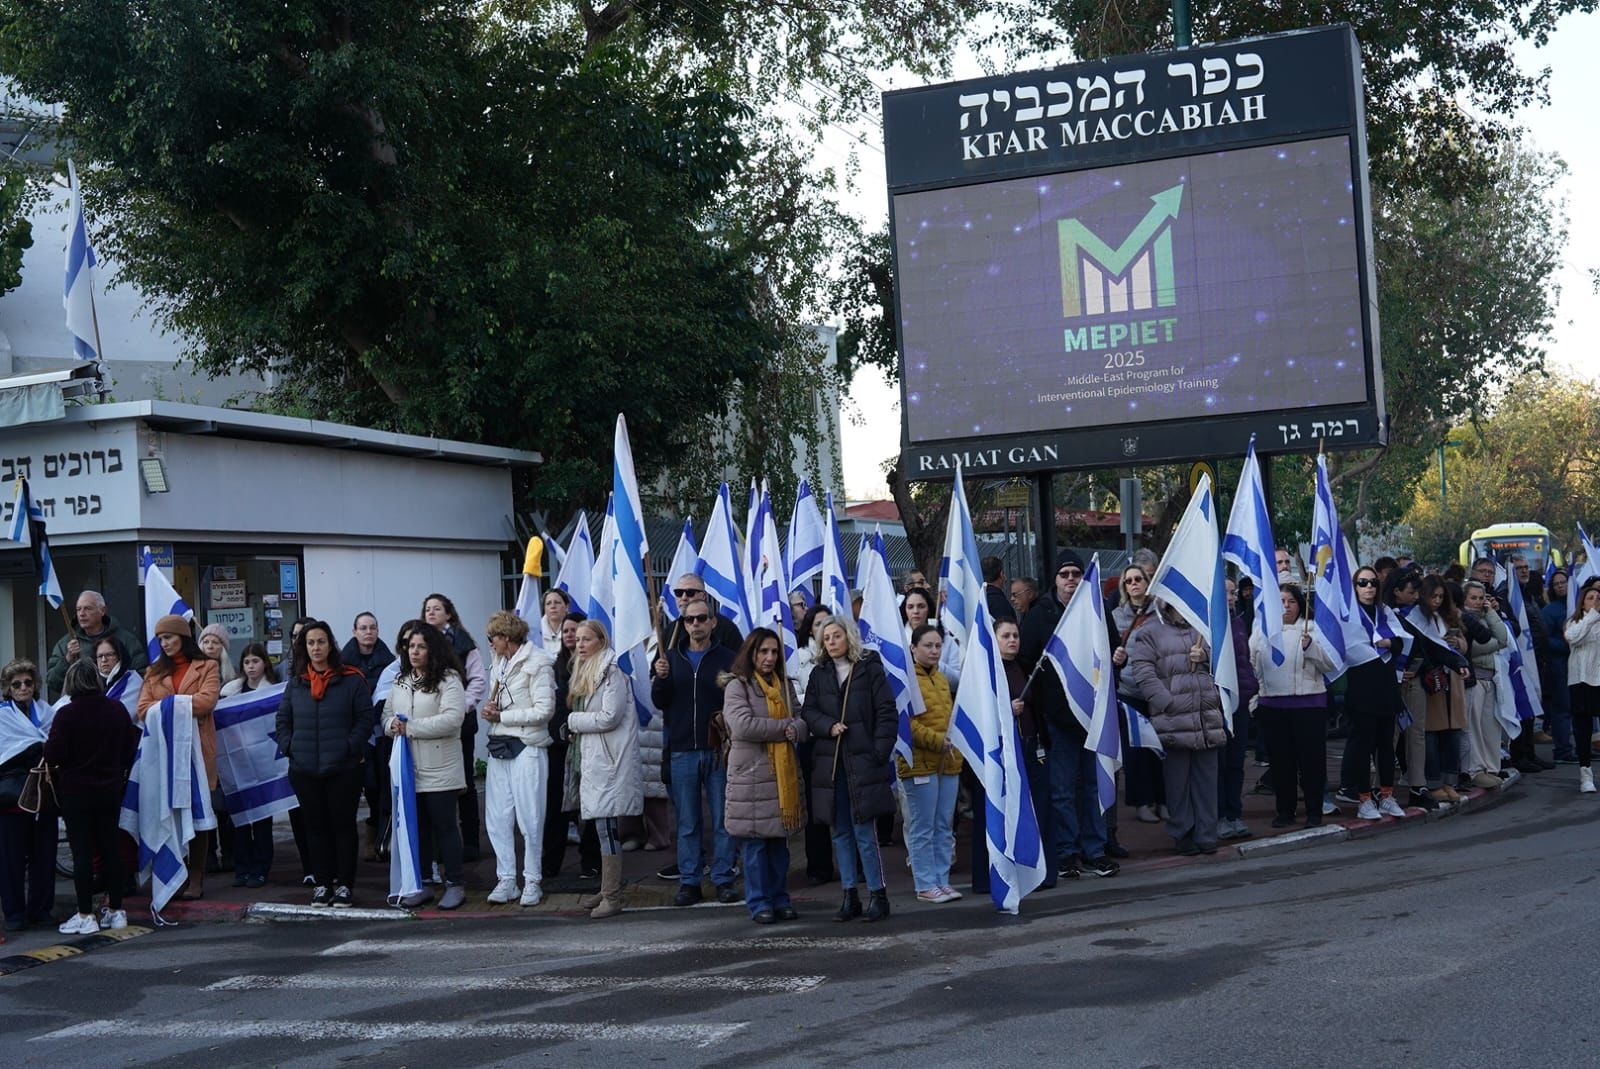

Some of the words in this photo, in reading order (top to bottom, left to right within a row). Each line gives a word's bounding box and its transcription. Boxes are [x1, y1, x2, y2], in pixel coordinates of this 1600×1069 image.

[1167, 52, 1265, 97] כפר
[959, 69, 1147, 130] המכביה
[961, 126, 1049, 160] KFAR
[1060, 94, 1267, 147] MACCABIAH
[1064, 318, 1177, 352] MEPIET
[1104, 350, 1145, 369] 2025
[1067, 371, 1124, 386] Middle-East
[1126, 368, 1168, 382] Program
[1171, 365, 1185, 376] for
[1038, 385, 1105, 402] Interventional
[1108, 381, 1175, 398] Epidemiology
[1177, 377, 1219, 391] Training
[1278, 424, 1301, 445] גן
[1311, 419, 1359, 438] רמת
[43, 448, 123, 478] ברוכים
[919, 449, 1001, 471] RAMAT
[1008, 444, 1058, 464] GAN
[64, 495, 102, 516] כפר
